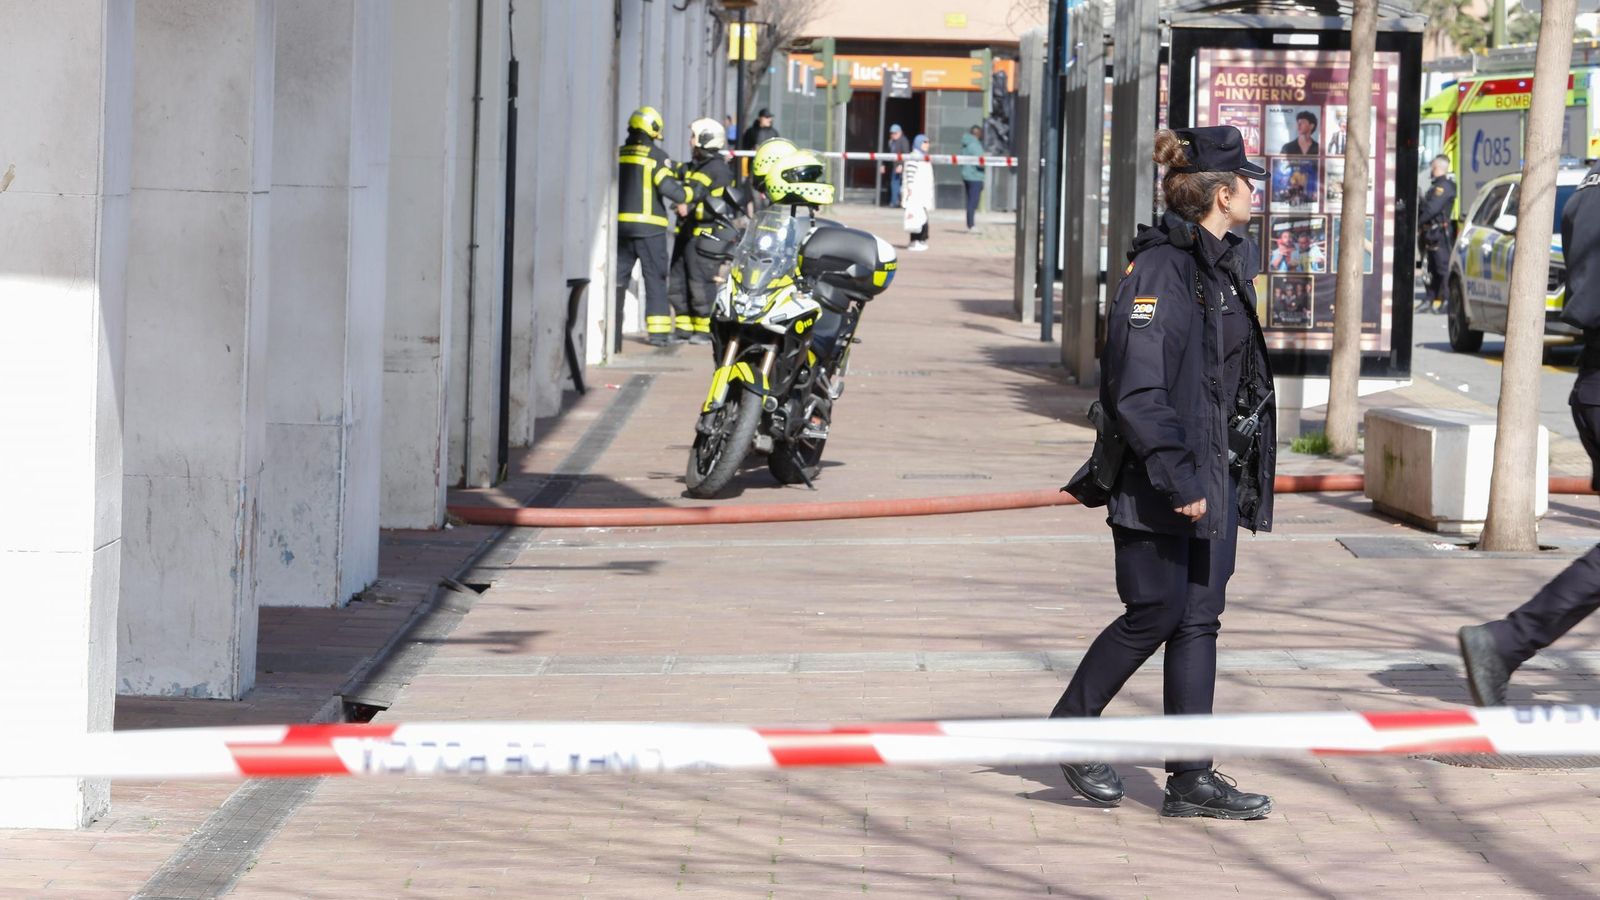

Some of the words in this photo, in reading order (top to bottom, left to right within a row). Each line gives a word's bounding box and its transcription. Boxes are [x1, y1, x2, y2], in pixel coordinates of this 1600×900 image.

[1215, 73, 1306, 88] ALGECIRAS
[1225, 87, 1305, 101] INVIERNO
[1496, 95, 1530, 108] BOMB
[1483, 137, 1511, 166] 085
